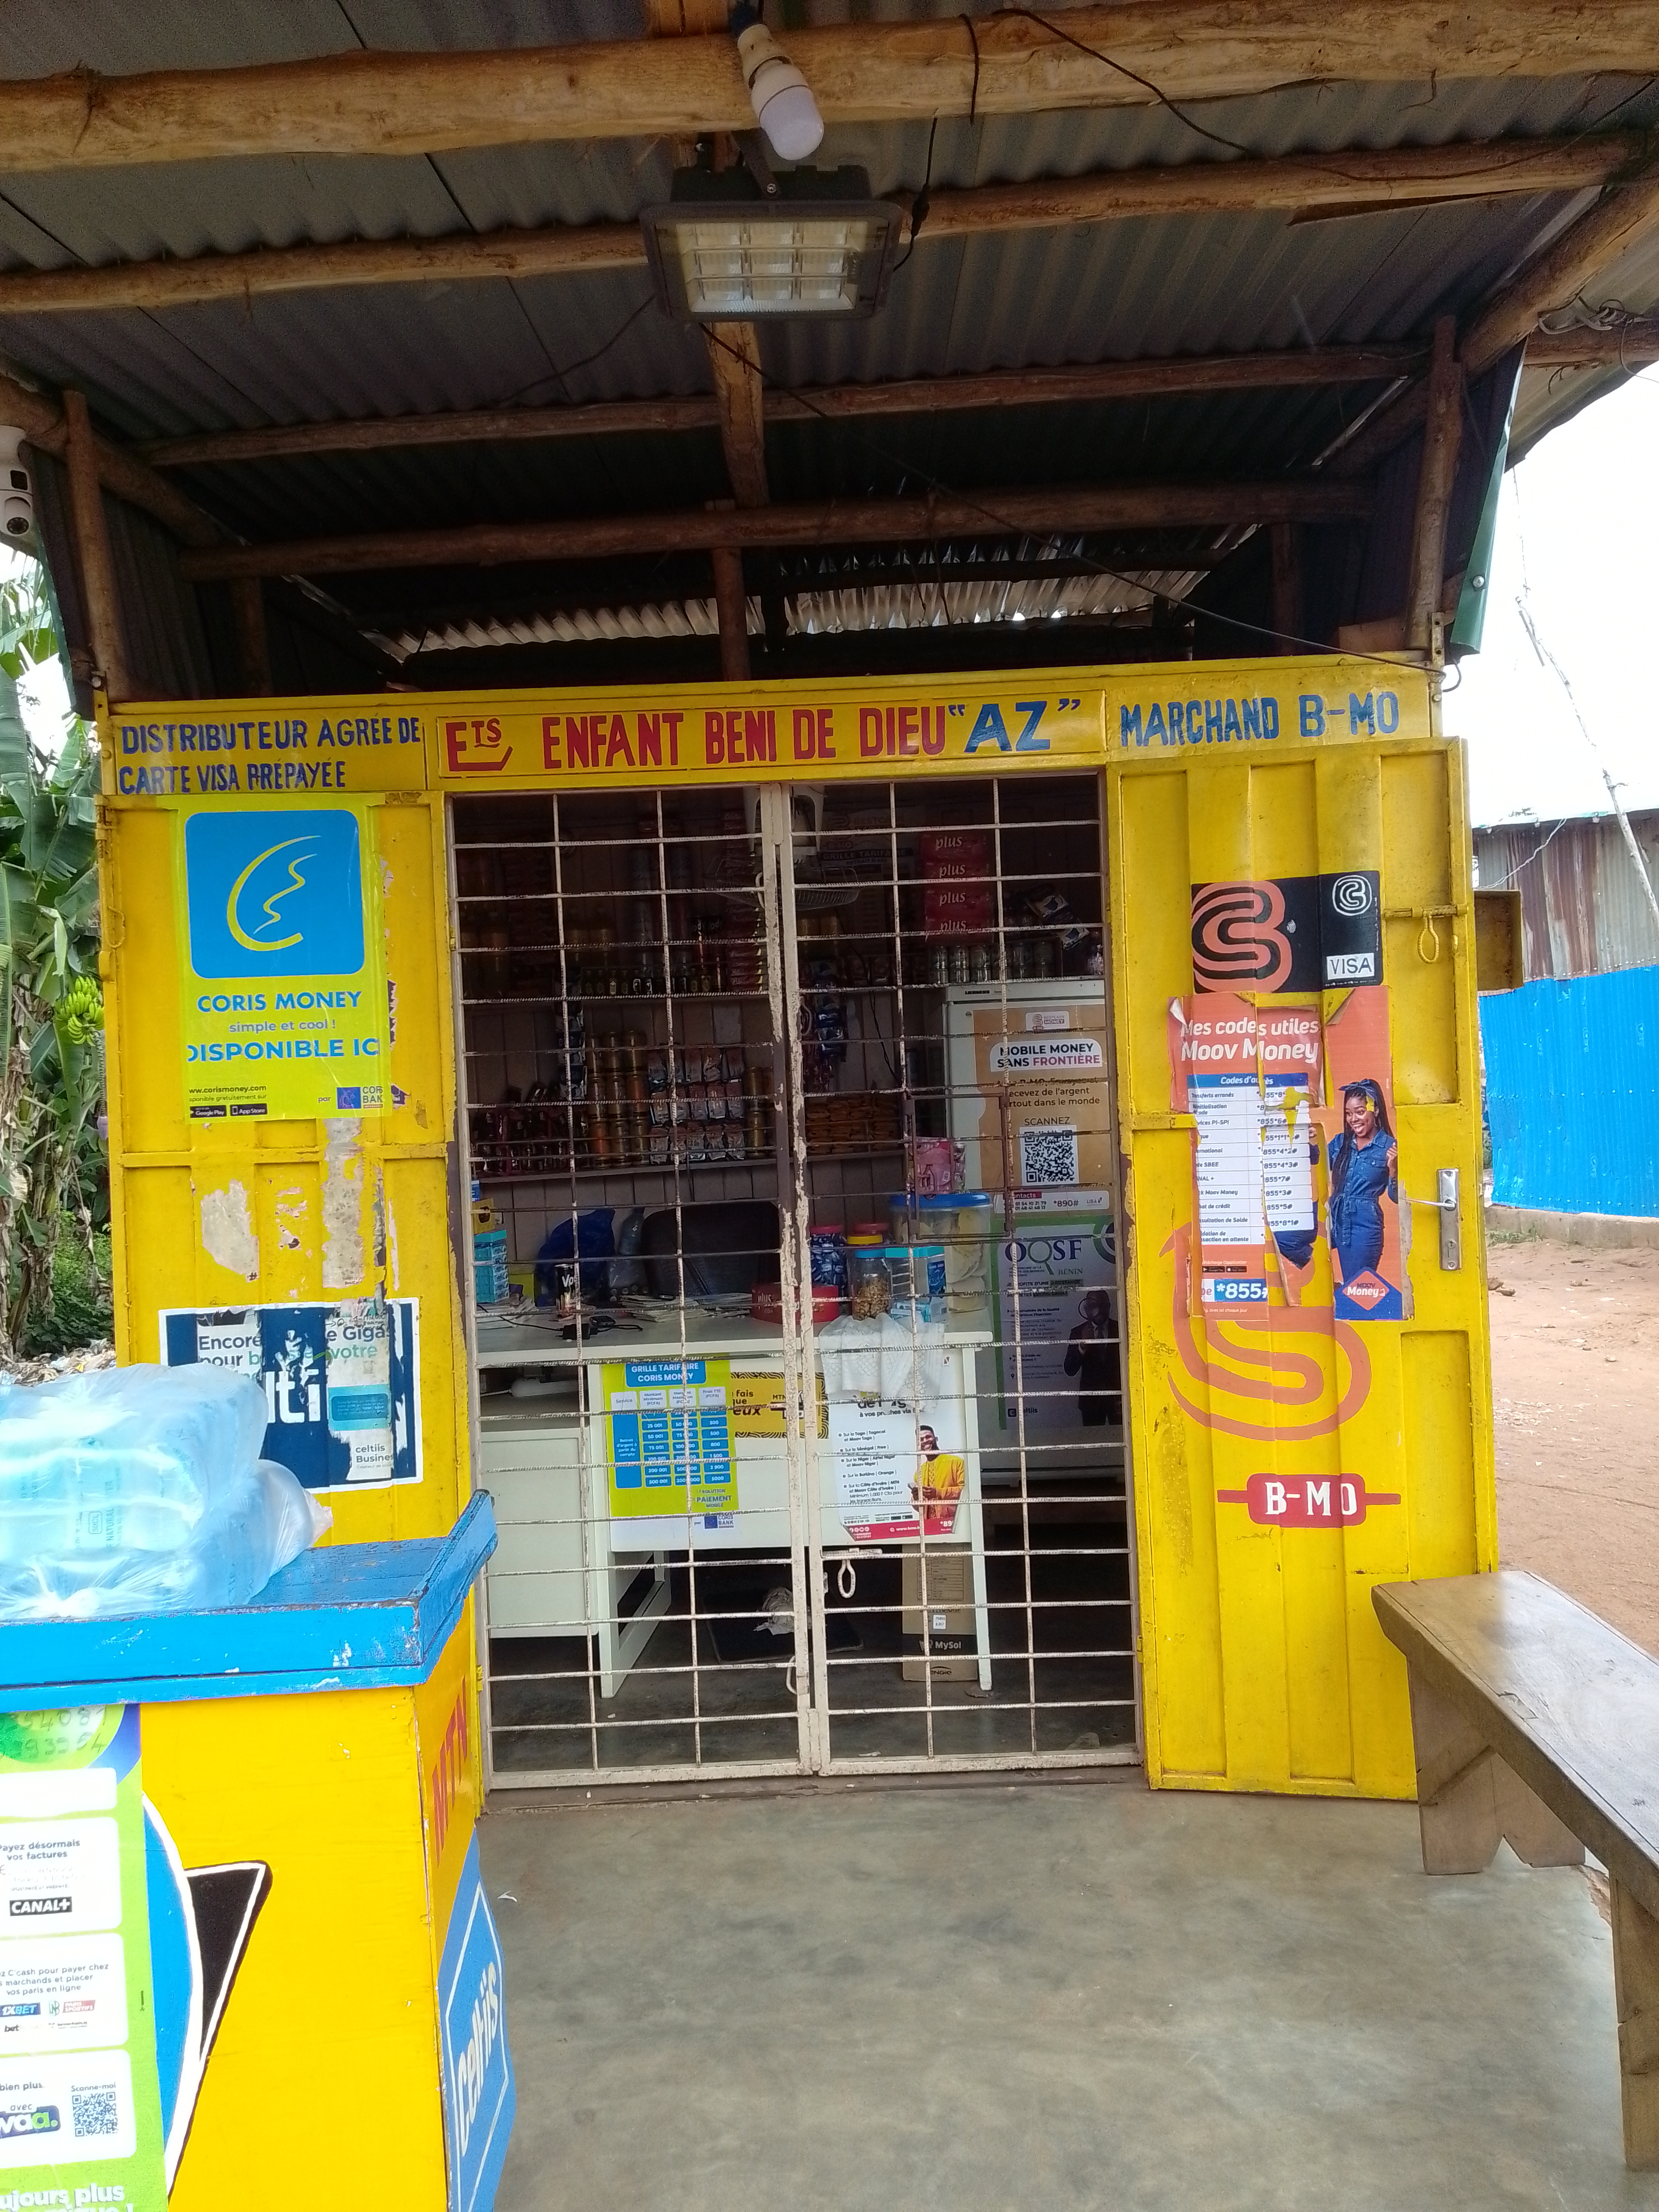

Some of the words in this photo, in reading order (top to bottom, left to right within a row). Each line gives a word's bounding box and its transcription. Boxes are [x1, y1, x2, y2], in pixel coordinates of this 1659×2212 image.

[1120, 697, 1279, 747] MARCHAND
[1298, 691, 1399, 738] B-MO
[122, 720, 307, 754] DISTRIBUTEUR
[398, 717, 421, 743] DE
[542, 712, 684, 769] ENFANT
[705, 710, 777, 765] BENI
[793, 709, 836, 760] DE
[859, 705, 945, 757] DIEU
[119, 766, 190, 795] CARTE
[196, 764, 240, 792] VISA
[936, 836, 962, 850] plus
[939, 864, 966, 877] plus
[940, 892, 966, 906] plus
[1330, 958, 1372, 975] VISA
[197, 993, 266, 1012] CORIS
[275, 991, 362, 1010] MONEY
[229, 1021, 276, 1034] simple
[281, 1021, 295, 1030] et
[298, 1019, 328, 1030] cool
[1216, 1017, 1267, 1036] codes
[1271, 1019, 1319, 1035] utiles
[1050, 1043, 1094, 1054] MONEY
[1181, 1041, 1239, 1061] Moov
[1243, 1038, 1319, 1063] Money
[1033, 1053, 1100, 1066] FRONTIÈRE
[1055, 1087, 1090, 1096] l'argent
[1025, 1117, 1070, 1126] SCANNEZ
[1347, 1287, 1379, 1297] Money
[330, 1344, 377, 1359] votre
[658, 1363, 699, 1371] TARIFIRE
[355, 1444, 386, 1453] celtiis
[1265, 1481, 1358, 1516] B-MO
[935, 1641, 961, 1650] MySol
[433, 1675, 467, 1867] MTN
[29, 1839, 80, 1849] désormais
[27, 1851, 68, 1859] factures
[11, 1898, 70, 1914] CANAL+
[6, 1977, 52, 1986] marchands
[66, 1974, 93, 1983] placer
[22, 1987, 44, 1996] paris
[71, 2082, 116, 2092] Scanne-moi
[74, 2182, 125, 2208] plus
